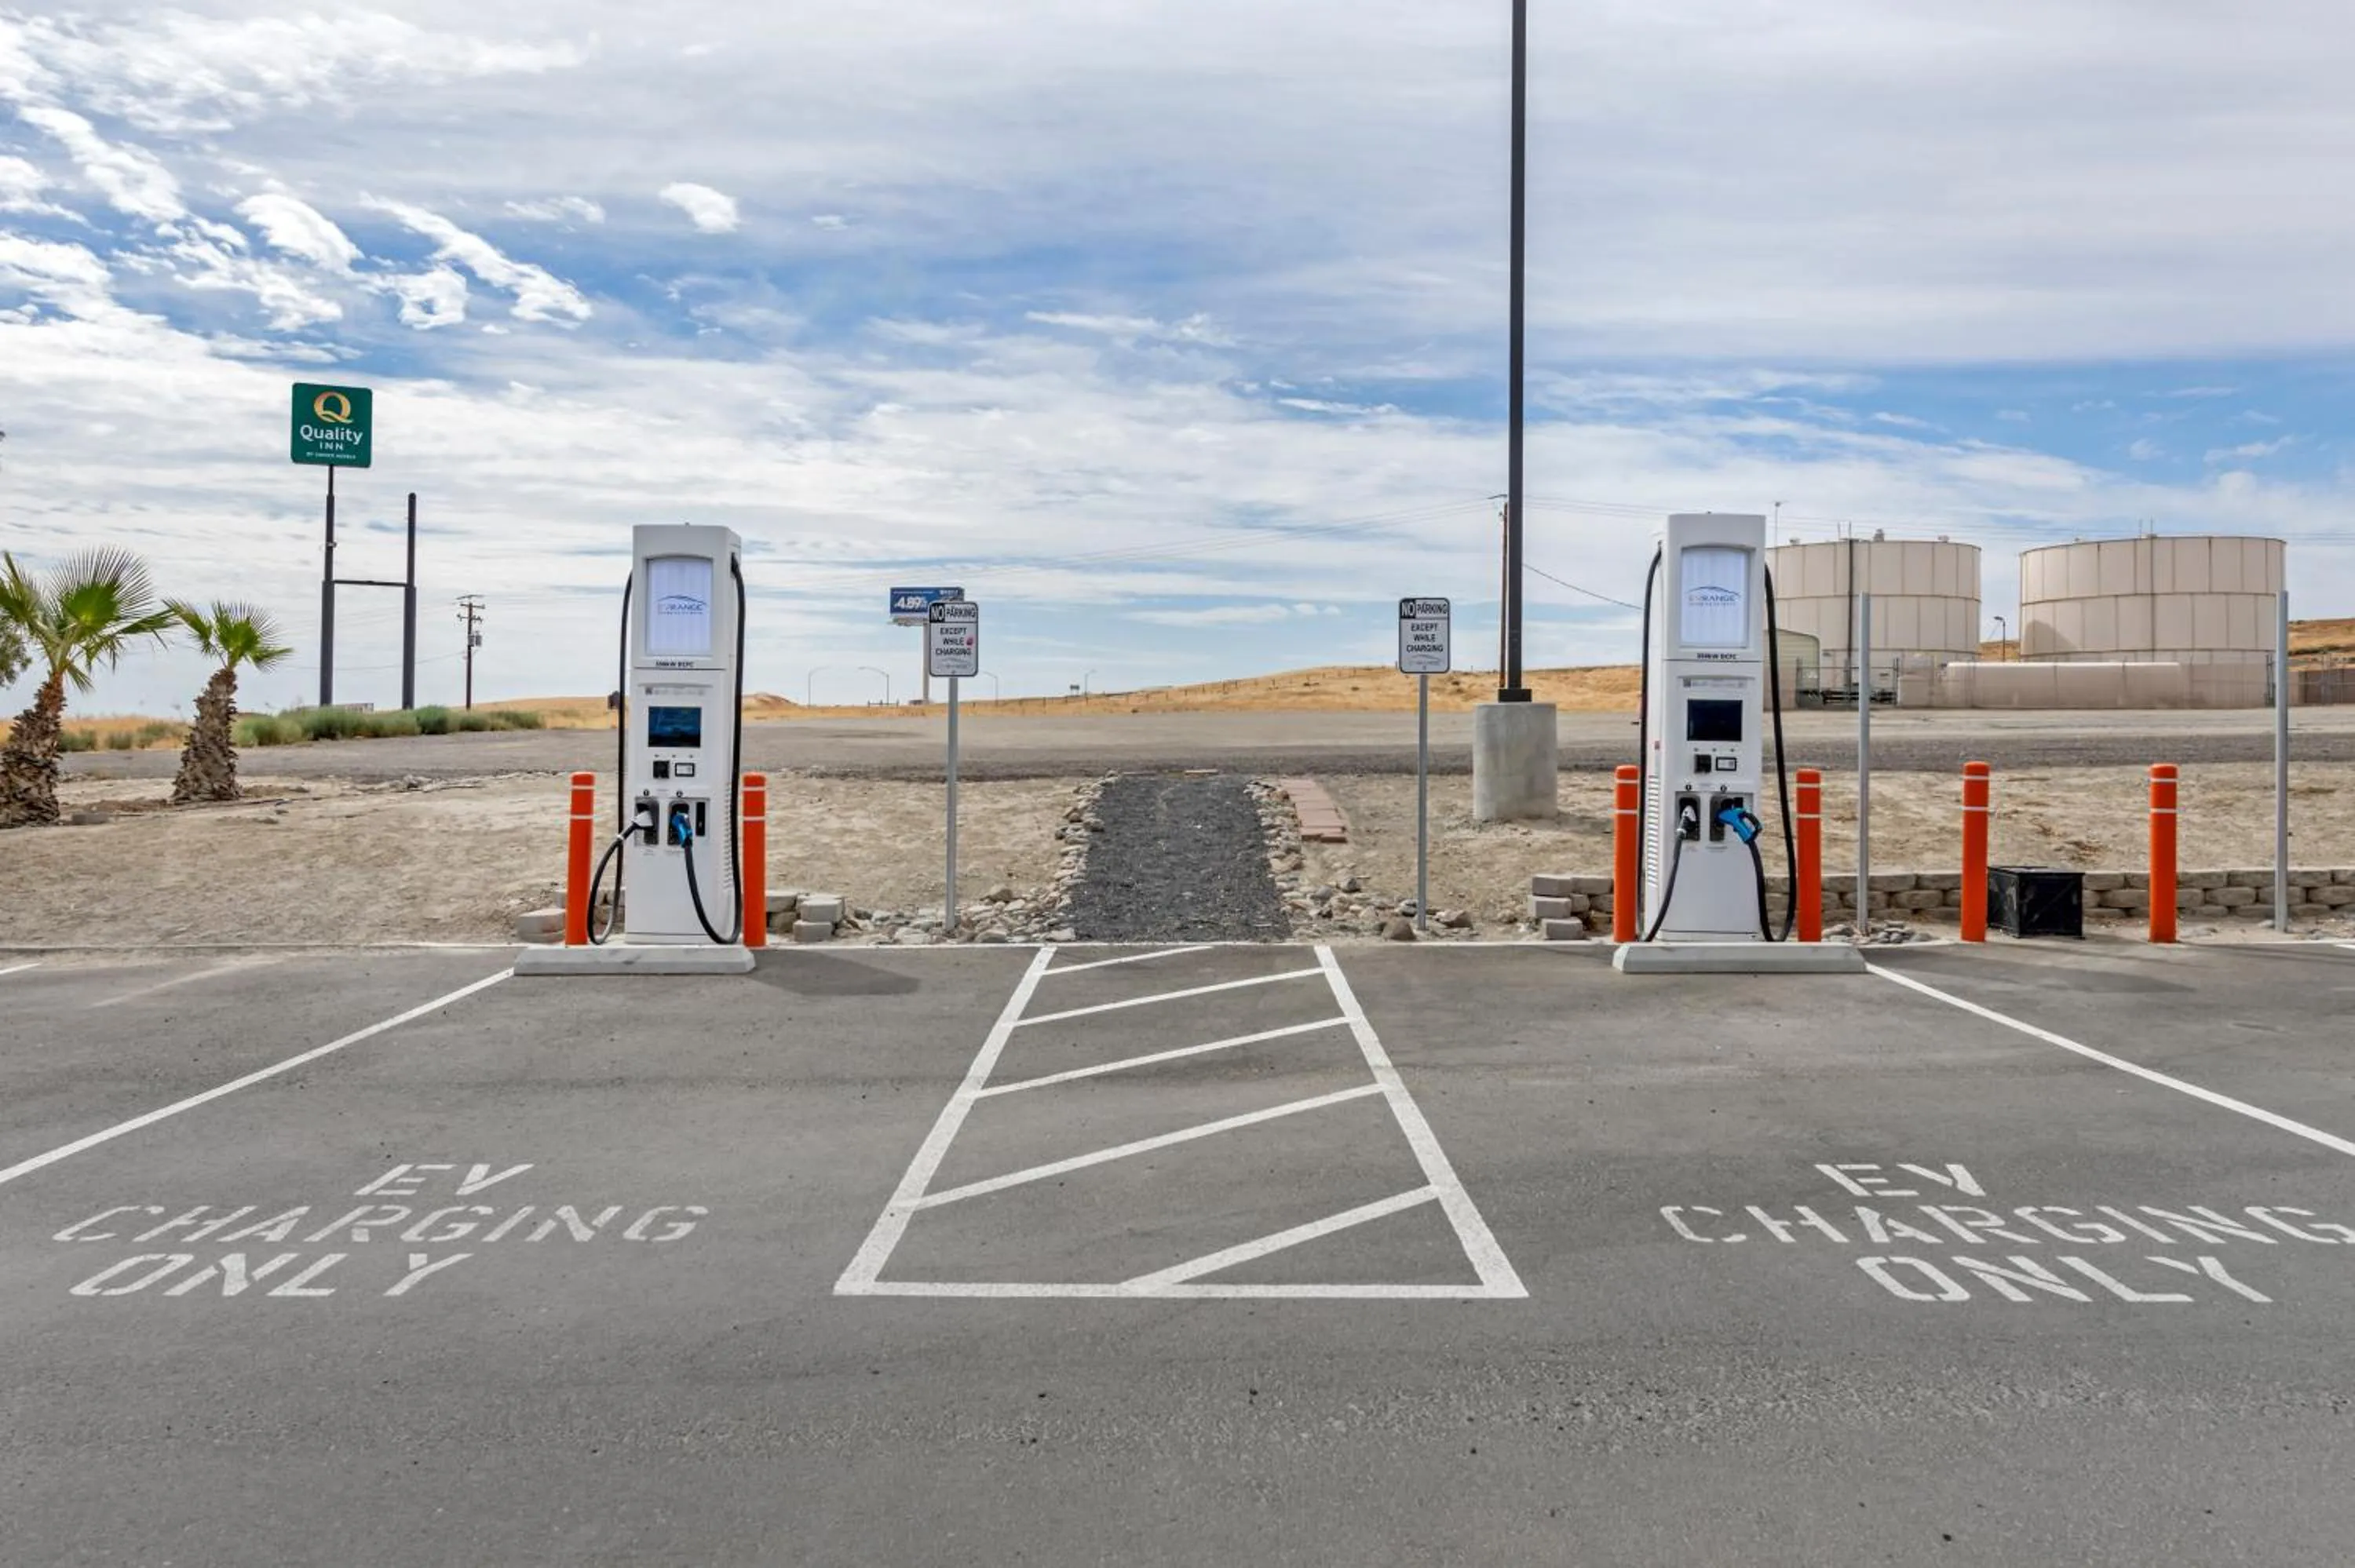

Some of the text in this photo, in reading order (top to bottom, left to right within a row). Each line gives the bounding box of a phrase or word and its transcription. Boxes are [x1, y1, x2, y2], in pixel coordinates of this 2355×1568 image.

[300, 425, 363, 445] Quality
[319, 442, 344, 450] INN
[931, 604, 975, 620] NO PARKING
[1401, 602, 1448, 616] NO PARKING
[1411, 623, 1438, 632] EXCEPT
[1414, 633, 1436, 642] WHILE
[353, 1164, 534, 1196] EV
[1814, 1164, 1986, 1196] EV
[52, 1205, 709, 1242] CHARGING
[1659, 1205, 2355, 1244] CHARGING
[69, 1253, 475, 1296] ONLY
[1856, 1256, 2273, 1303] ONLY
